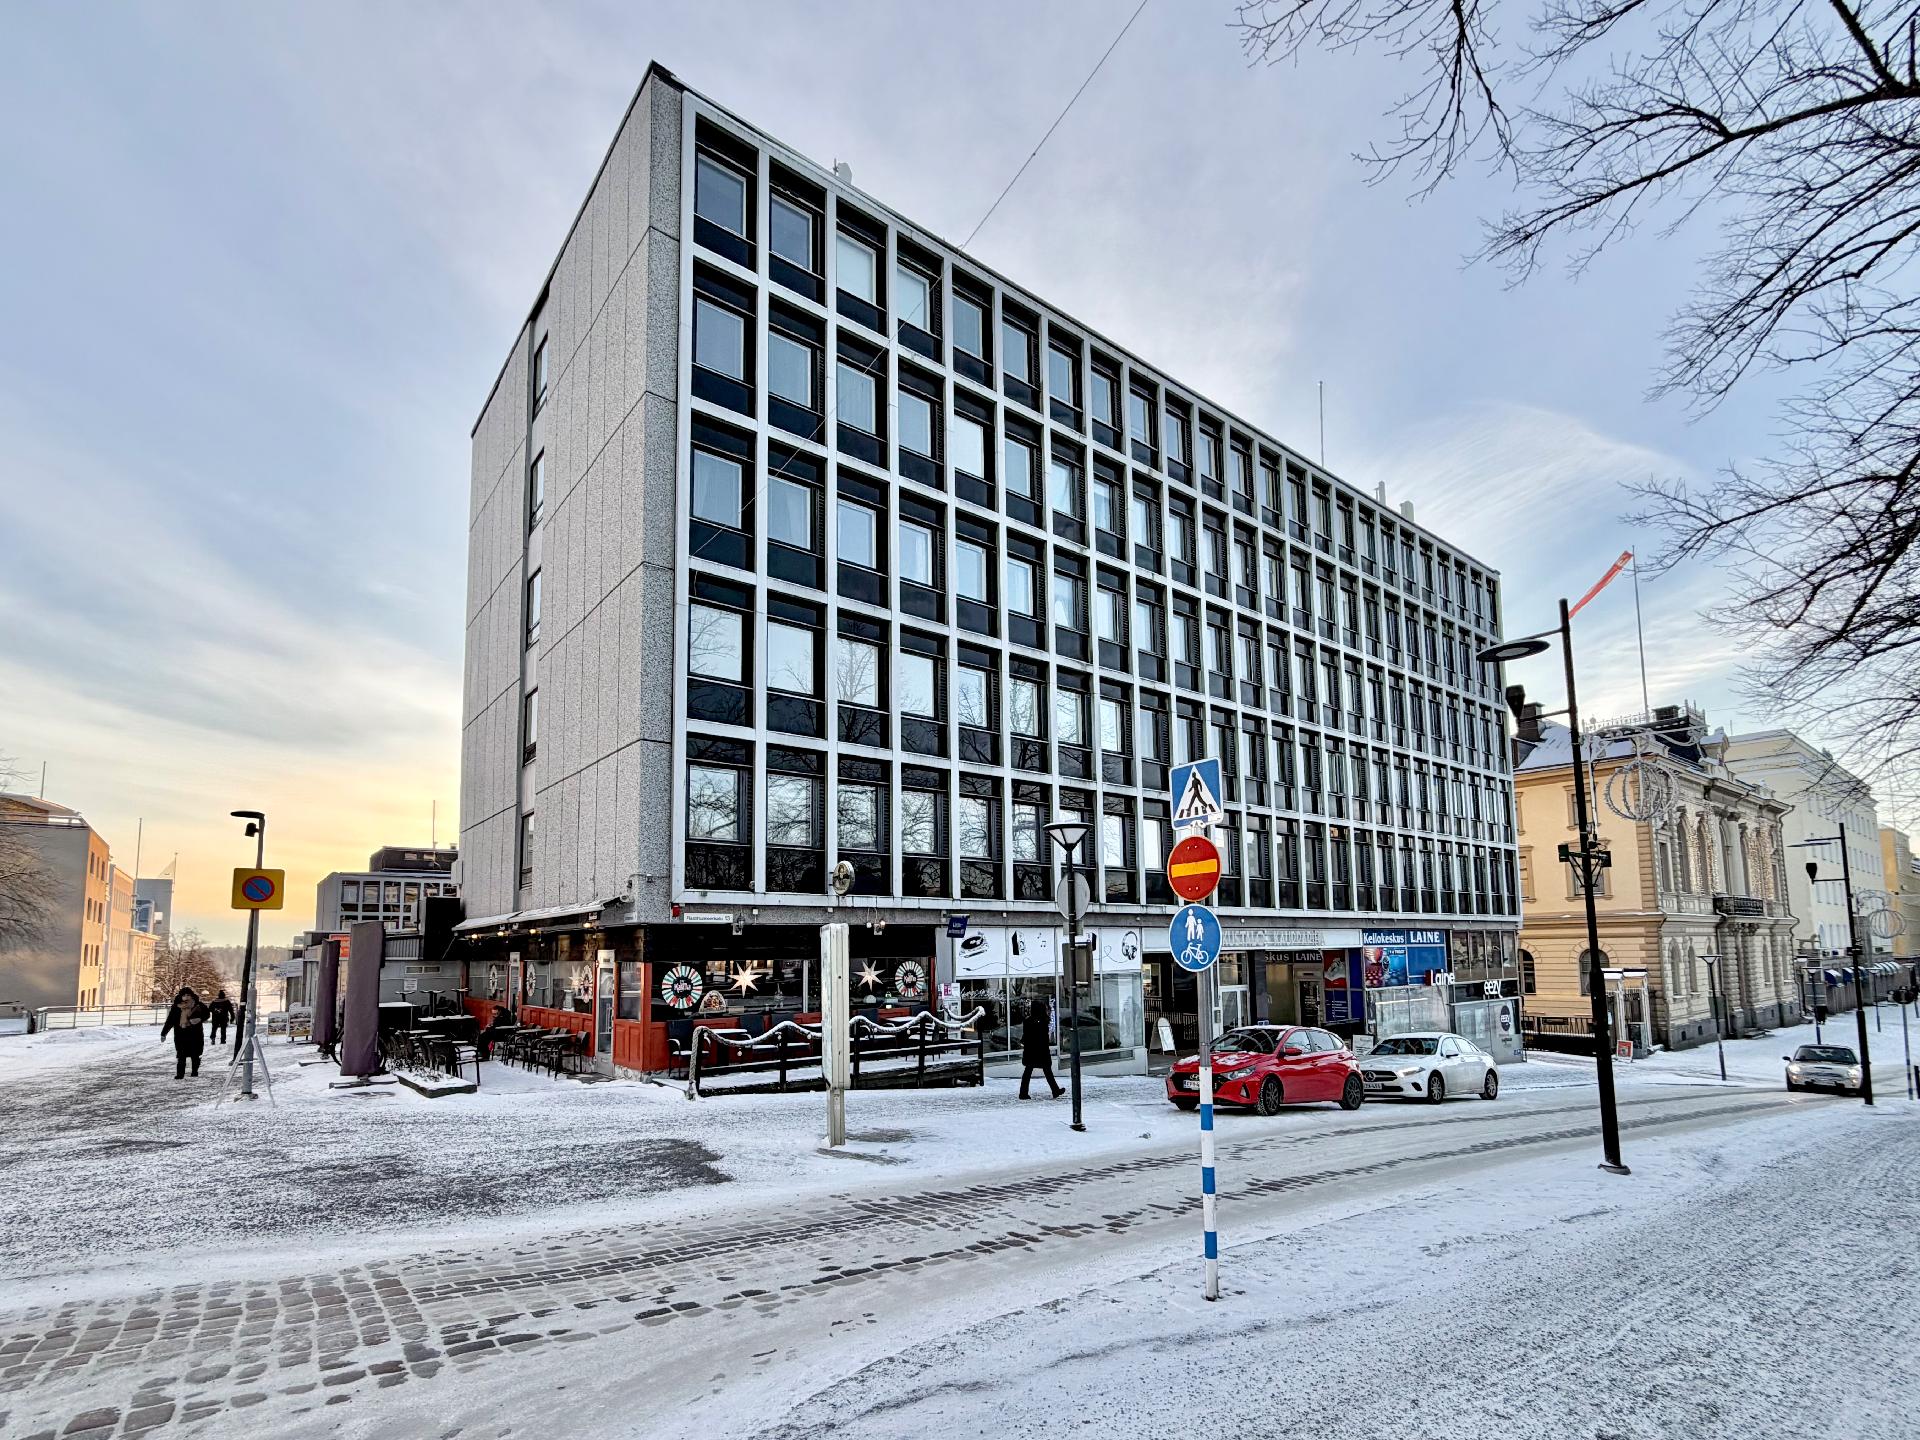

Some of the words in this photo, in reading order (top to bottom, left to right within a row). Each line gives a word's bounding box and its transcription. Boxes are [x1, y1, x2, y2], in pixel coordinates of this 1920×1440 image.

[1363, 932, 1405, 944] Kellokeskus
[1410, 931, 1440, 943] LAINE
[1295, 952, 1322, 961] LAINE
[1430, 969, 1455, 985] Laine
[1484, 980, 1503, 998] eezy
